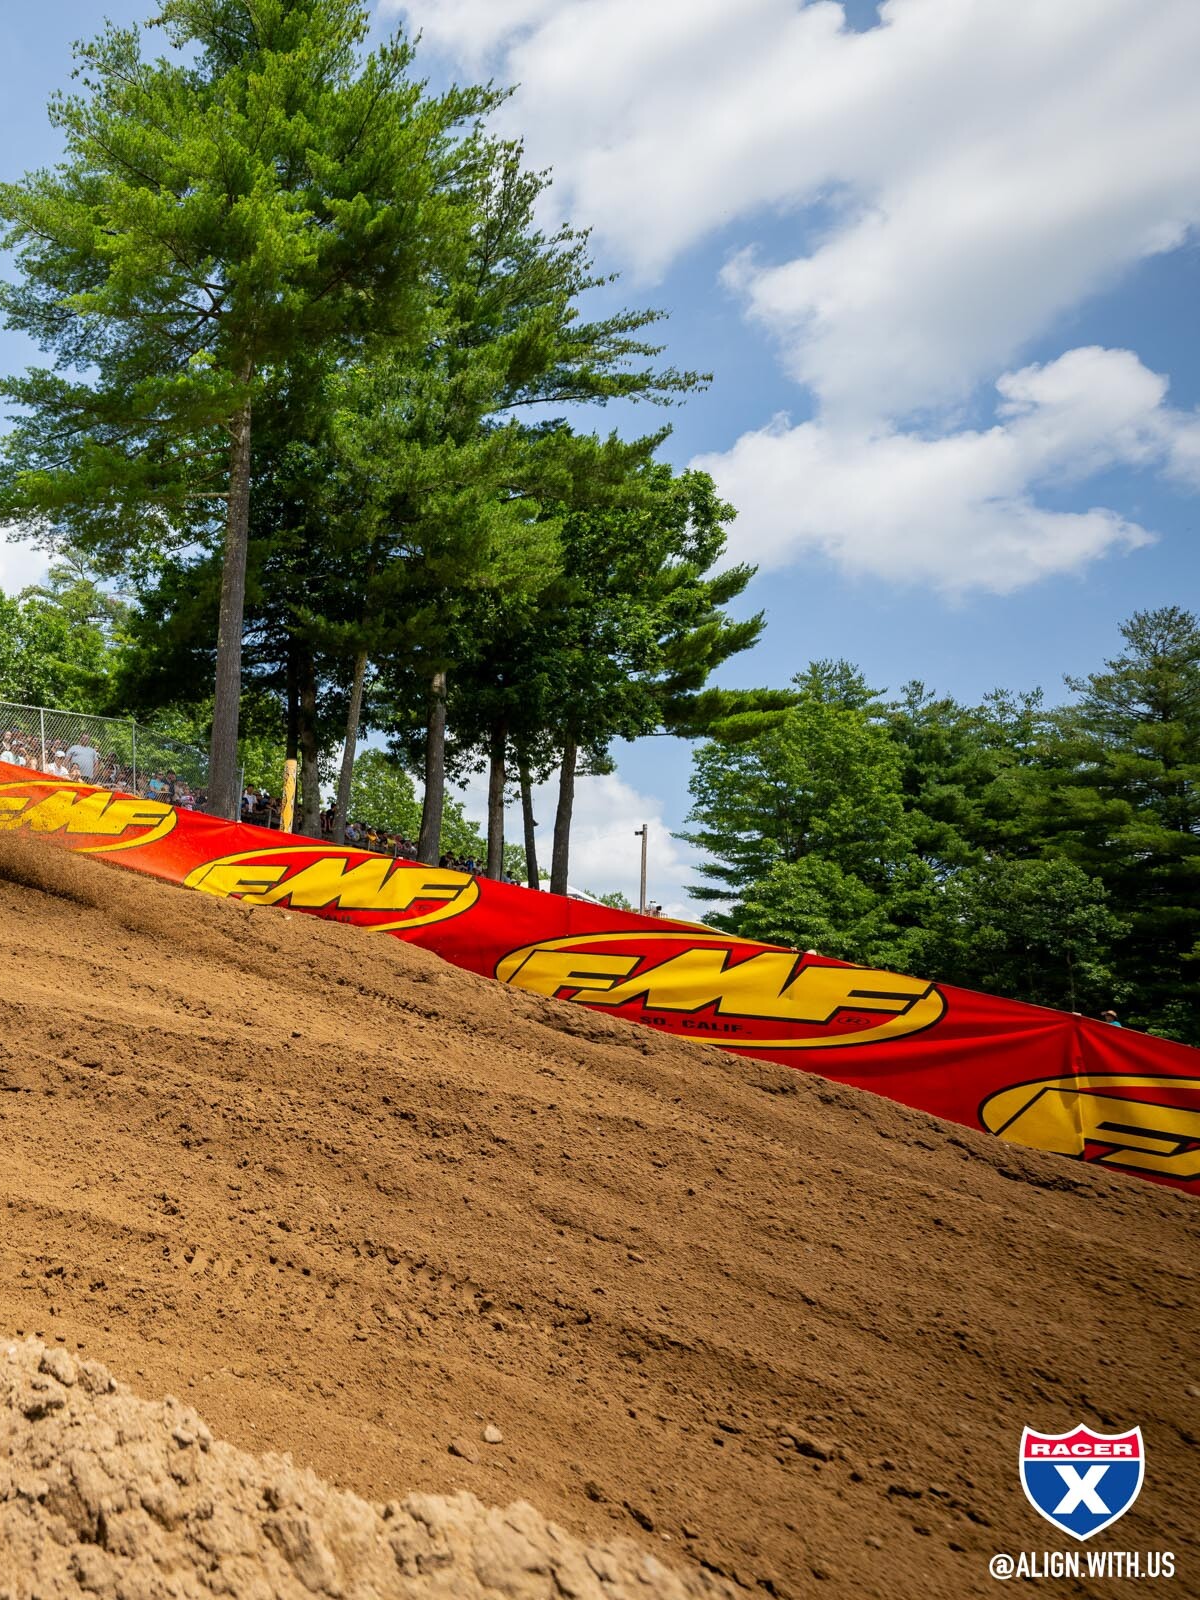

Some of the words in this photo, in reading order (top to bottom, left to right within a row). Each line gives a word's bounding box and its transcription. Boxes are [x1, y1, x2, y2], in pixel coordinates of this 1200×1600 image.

[194, 857, 475, 911] FMF
[508, 949, 936, 1025] FMF
[681, 1019, 753, 1034] CALIF.
